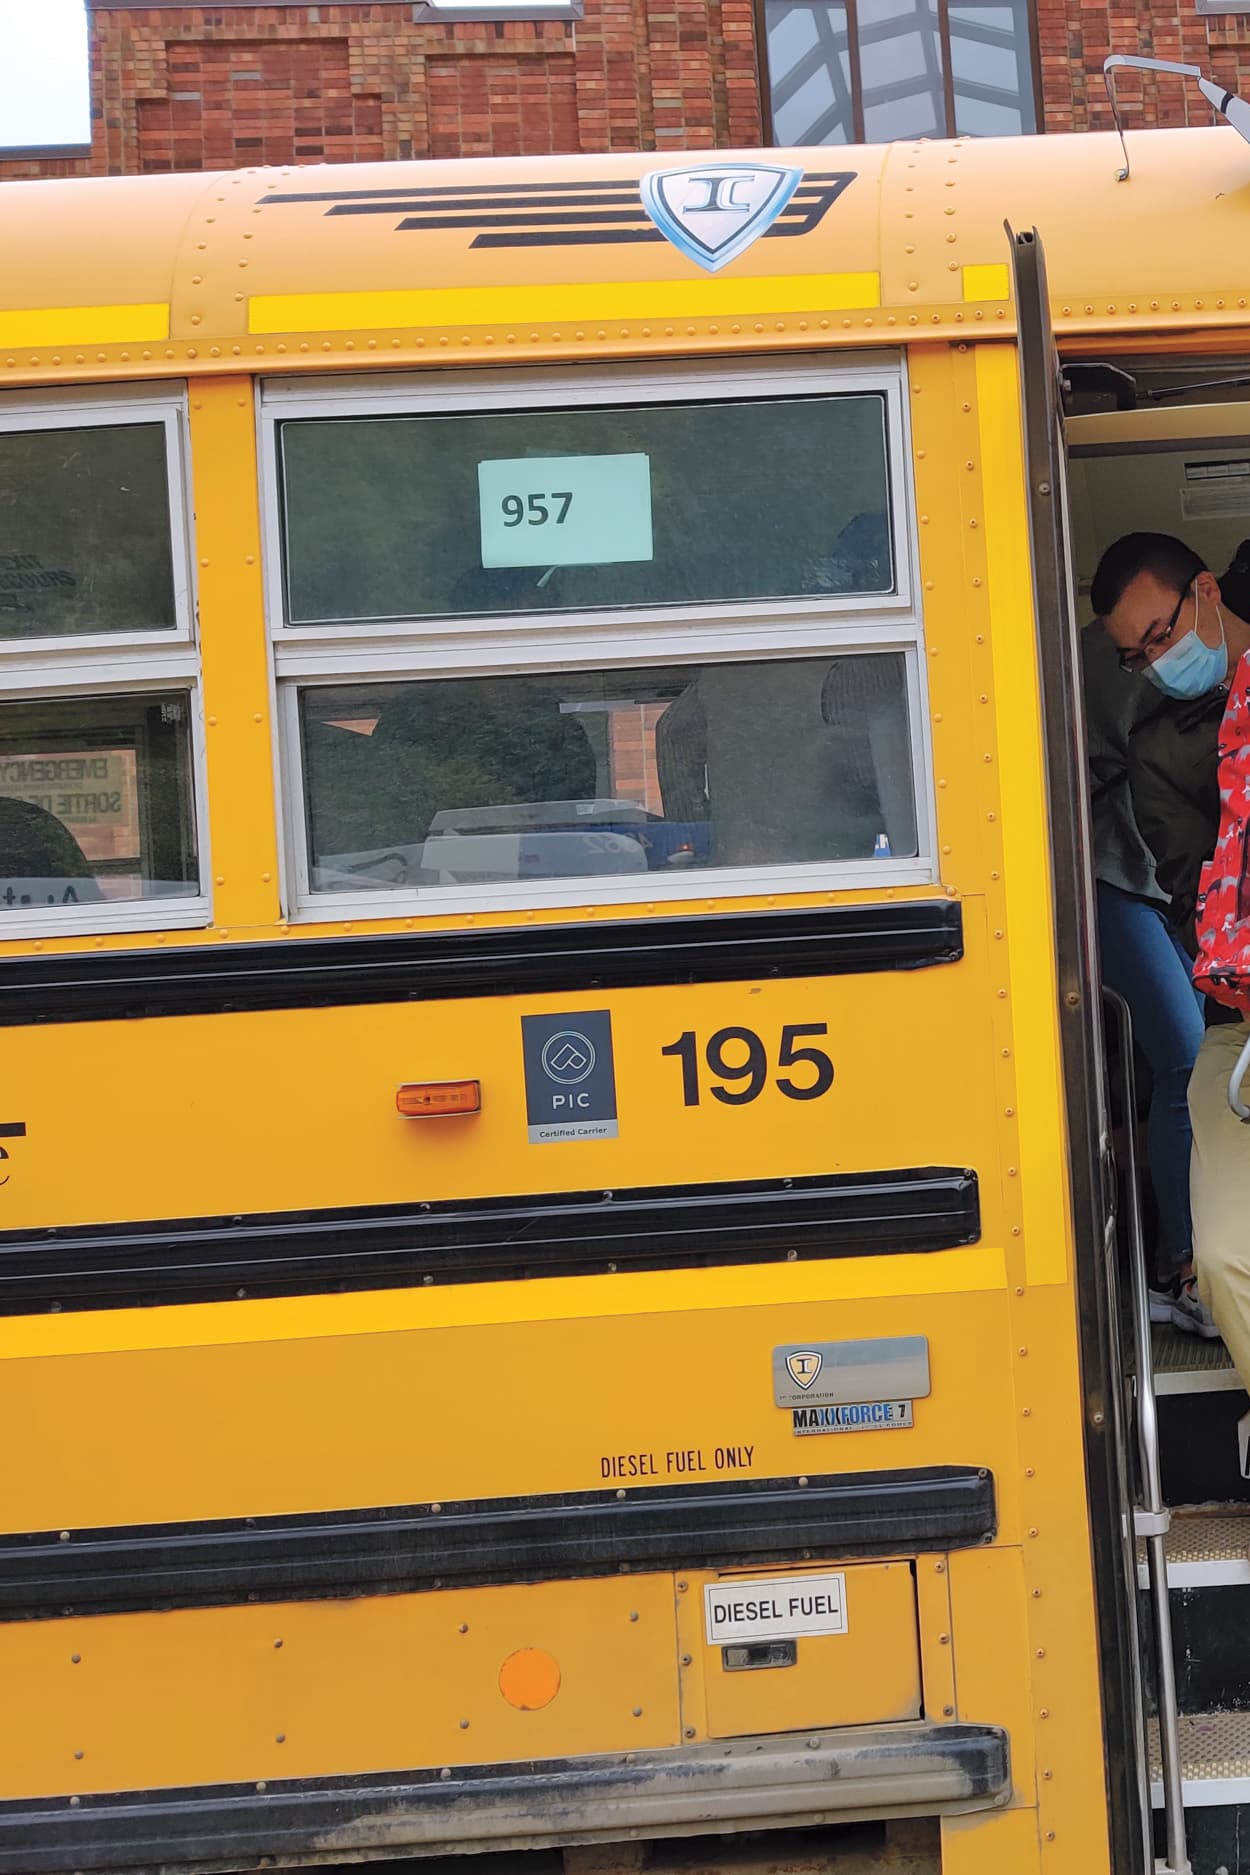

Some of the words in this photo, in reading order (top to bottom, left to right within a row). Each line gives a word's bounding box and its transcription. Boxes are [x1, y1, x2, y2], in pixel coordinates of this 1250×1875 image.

[501, 492, 573, 527] 957
[661, 1022, 835, 1106] 195
[552, 1093, 590, 1109] PIC
[539, 1128, 575, 1138] Certified
[577, 1126, 608, 1136] Carrier
[793, 1403, 894, 1428] MAXXFORCE
[898, 1404, 906, 1418] 7
[601, 1454, 658, 1478] DIESEL
[666, 1450, 706, 1473] FUEL
[714, 1446, 754, 1469] ONLY
[714, 1600, 782, 1624] DIESEL
[789, 1595, 838, 1617] FUEL
